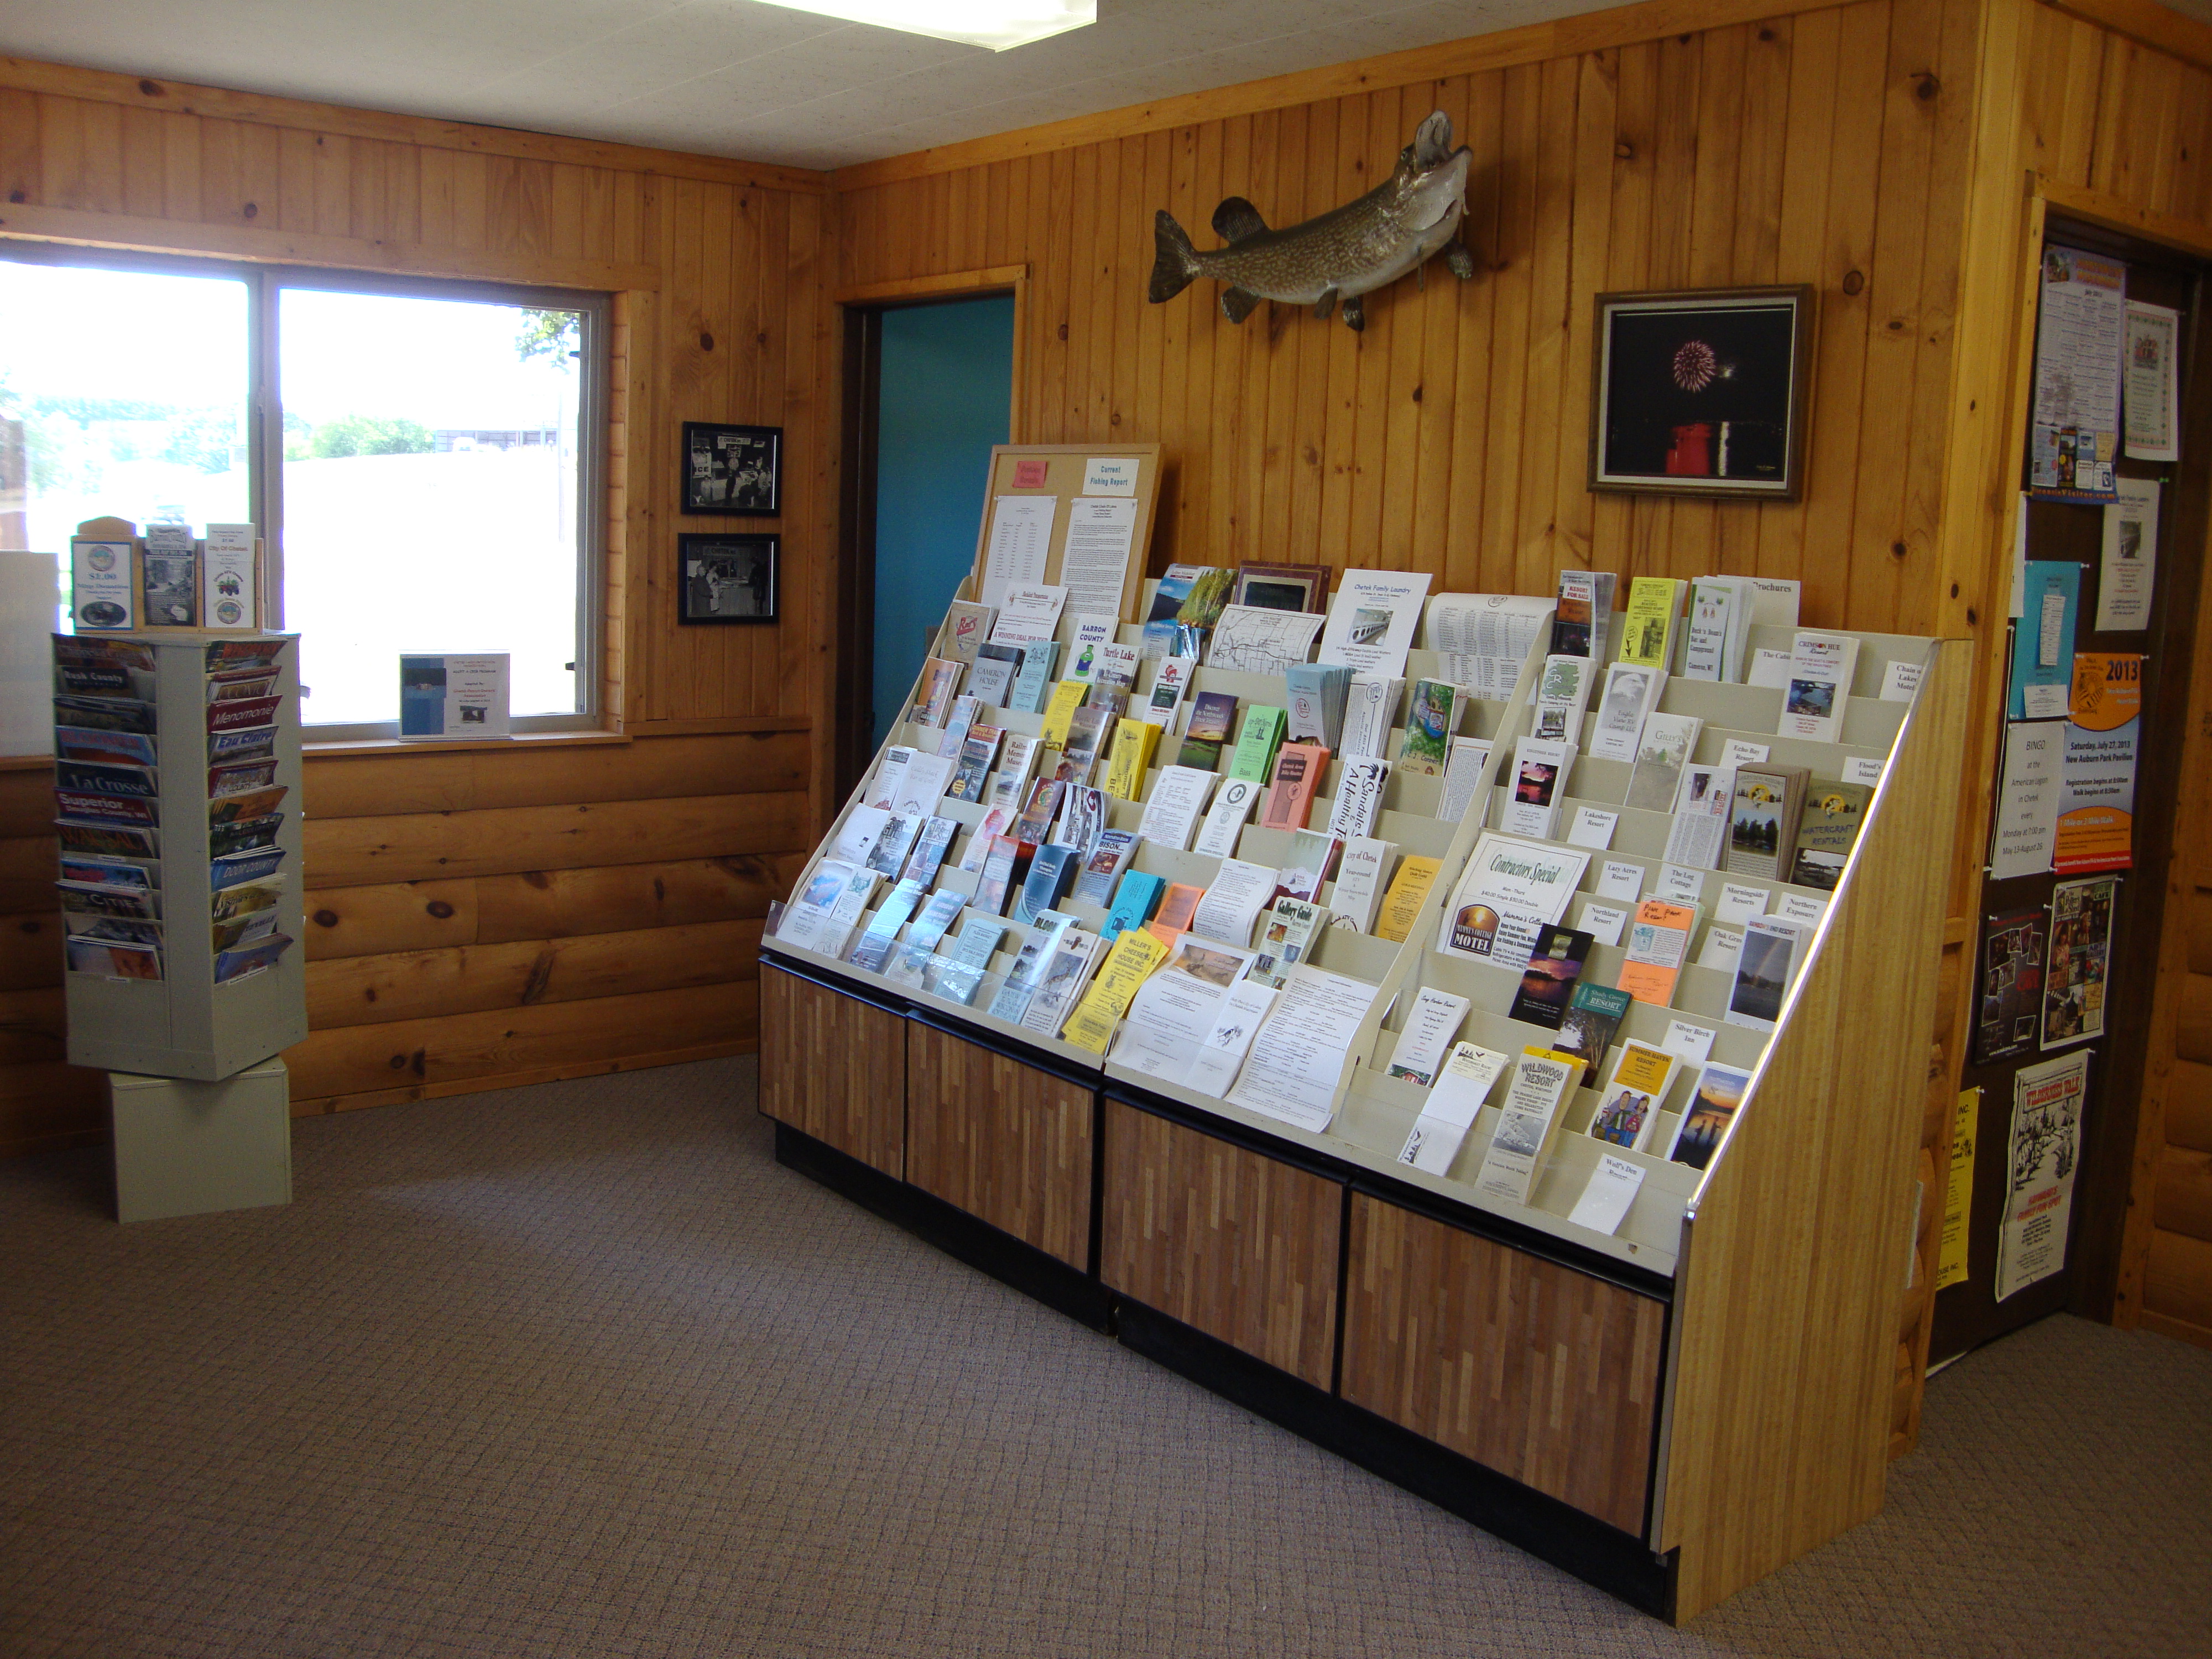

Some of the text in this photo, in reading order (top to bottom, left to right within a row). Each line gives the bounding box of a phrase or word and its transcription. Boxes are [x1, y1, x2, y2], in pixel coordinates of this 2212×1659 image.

[1090, 478, 1109, 486] Fishing
[1391, 586, 1411, 594] Laundry
[1103, 648, 1135, 661] Turtle Lake
[977, 667, 1005, 677] CAMERON
[2106, 660, 2138, 681] 2013
[91, 672, 123, 685] County
[979, 676, 998, 686] HOUSE
[1897, 682, 1914, 691] Motel
[212, 704, 274, 726] Menomonie
[221, 732, 273, 749] Eau Claire
[2026, 740, 2046, 750] BINGO
[2070, 742, 2096, 751] Saturday,
[2098, 741, 2107, 750] July
[1736, 754, 1754, 762] Resort
[1859, 761, 1881, 770] Flood's
[1239, 768, 1251, 777] Bass
[71, 775, 149, 795] La Crosse
[60, 795, 123, 809] Superior
[1355, 778, 1375, 829] Sandals
[1584, 811, 1611, 821] Lakeshore
[1802, 825, 1854, 835] WATERCRAFT
[1347, 852, 1355, 860] City
[1363, 852, 1377, 863] Chetek
[223, 860, 276, 878] DOOR COUNTY
[1345, 868, 1371, 878] Year-round
[1490, 854, 1561, 885] Contractors Special
[1608, 864, 1621, 873] Lazy
[1684, 873, 1694, 881] Log
[1670, 878, 1692, 889] Cottage
[1727, 886, 1764, 899] Morningside
[1732, 897, 1754, 905] Resorts
[1790, 898, 1817, 910] Northern
[1277, 900, 1312, 921] Gallery Guide
[1592, 907, 1619, 918] Northland
[1786, 907, 1814, 919] Exposure
[1594, 916, 1611, 925] Resort
[1129, 938, 1151, 950] MILLER'S
[1454, 933, 1489, 951] MOTEL
[1717, 941, 1737, 951] Resort
[1117, 954, 1144, 967] HOUSE INC.
[1590, 997, 1621, 1009] RESORT
[1675, 1024, 1710, 1037] Silver Birch
[1630, 1046, 1670, 1062] SUMMER HAVEN
[1636, 1057, 1656, 1066] RESORT
[1521, 1062, 1564, 1081] WILDWOOD
[1525, 1072, 1556, 1088] RESORT
[2025, 1076, 2080, 1108] WILDERNESS WALK
[1958, 1105, 1970, 1114] INC.
[1606, 1159, 1637, 1175] Wolf's Den
[2028, 1185, 2058, 1204] HAYWARD'S
[2017, 1204, 2036, 1222] FAMILY
